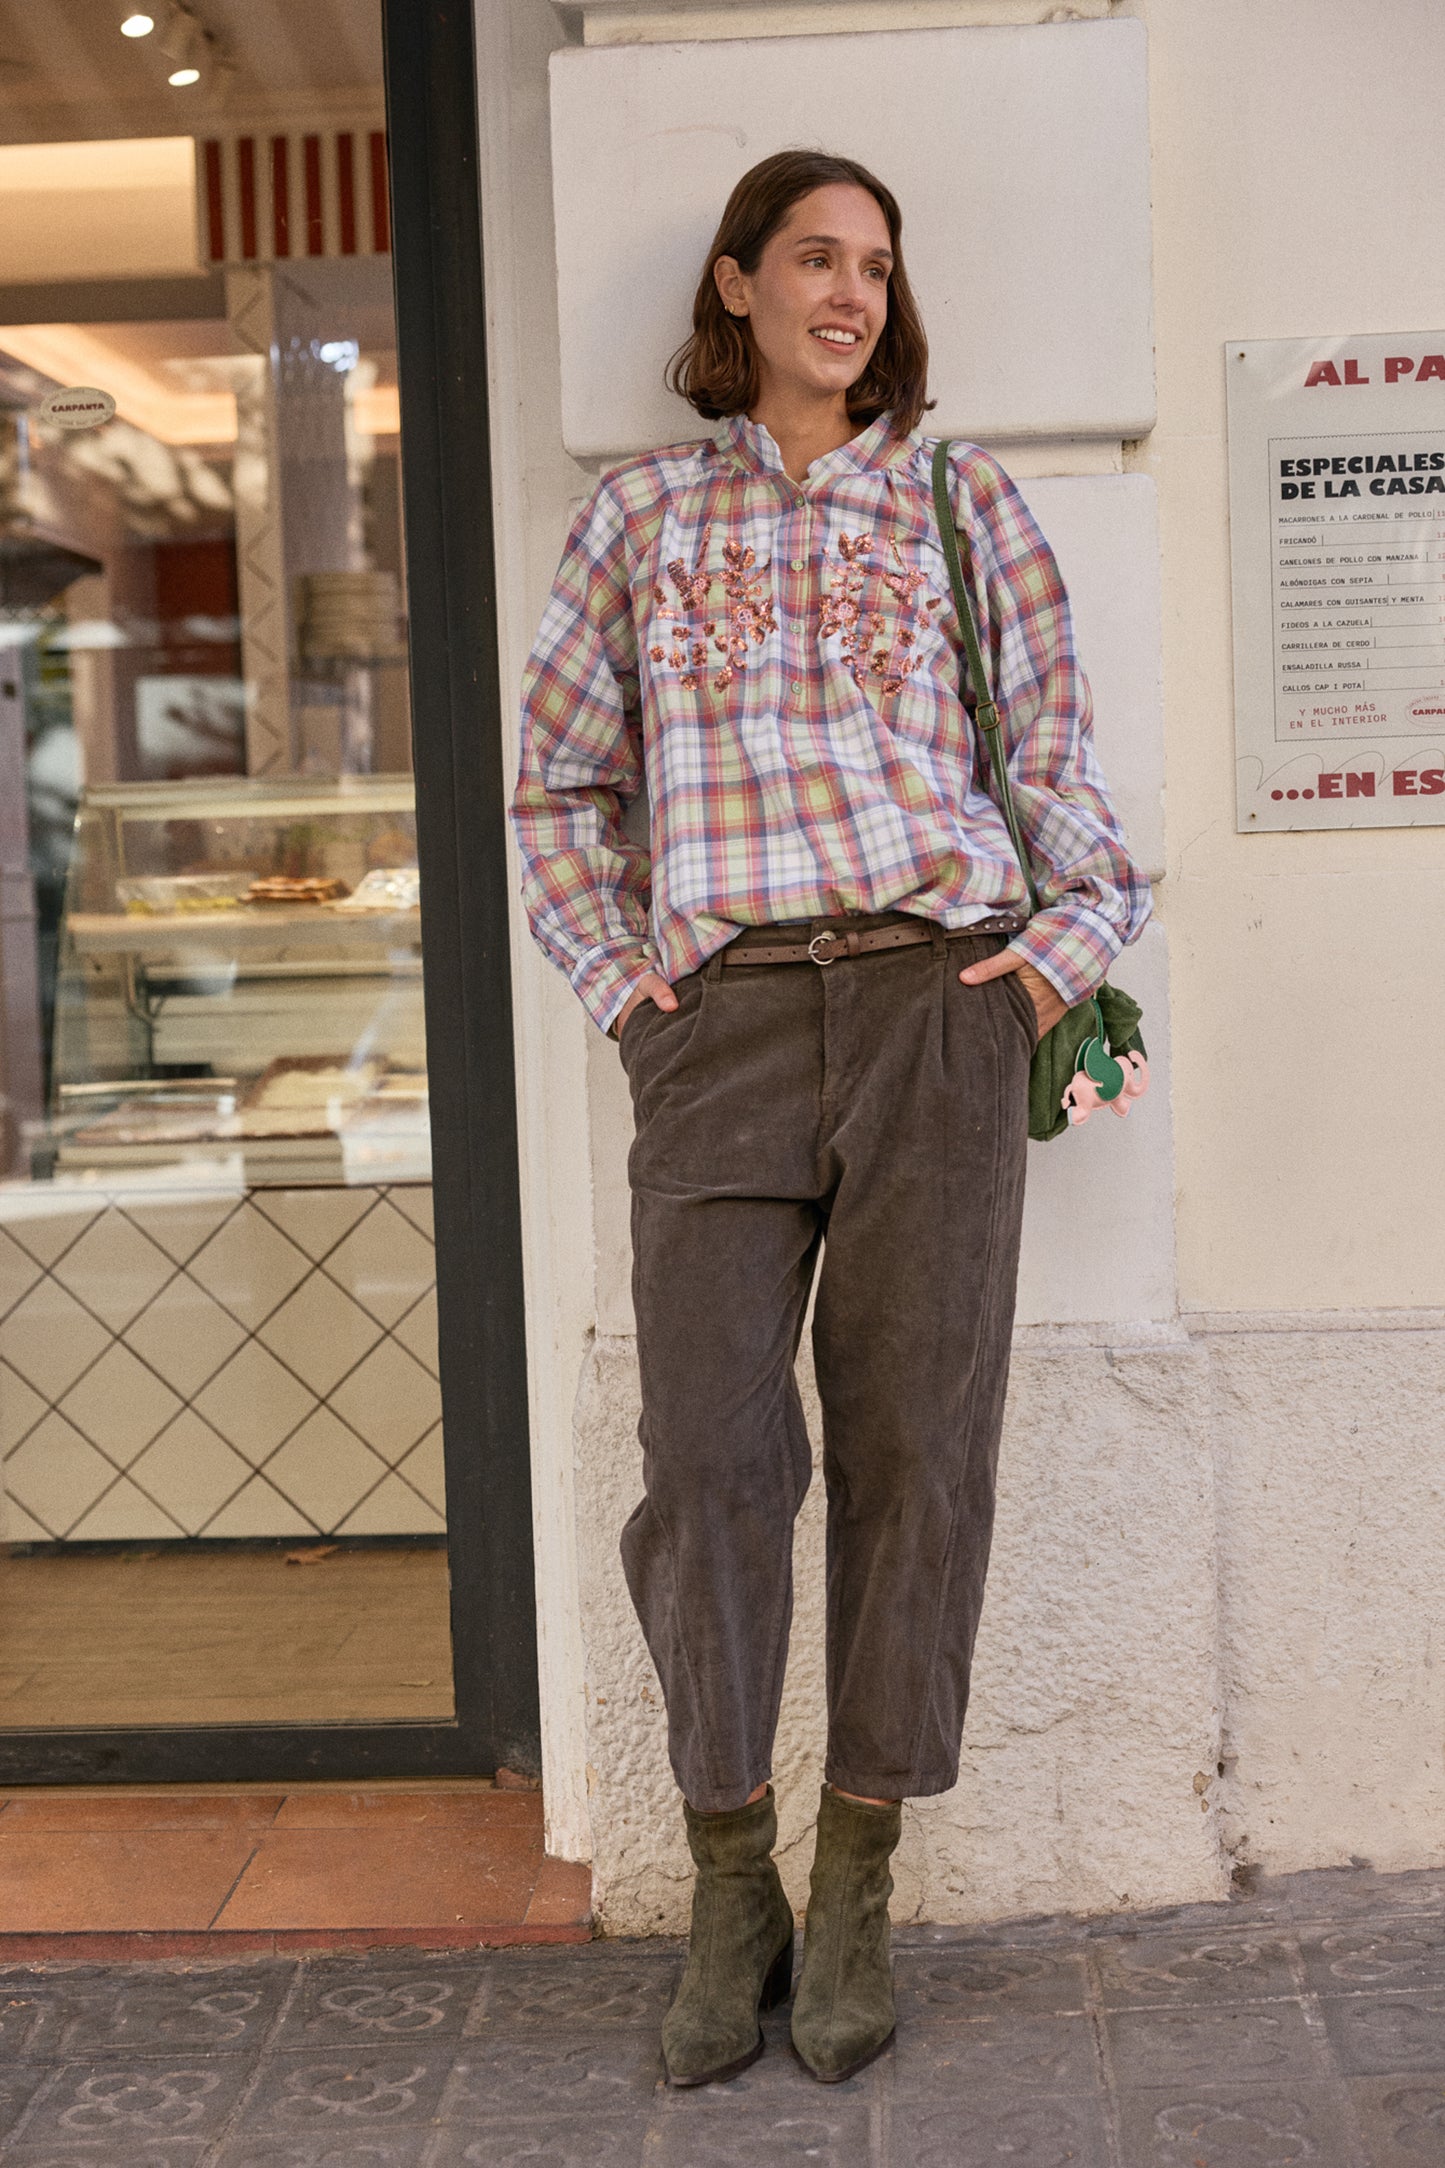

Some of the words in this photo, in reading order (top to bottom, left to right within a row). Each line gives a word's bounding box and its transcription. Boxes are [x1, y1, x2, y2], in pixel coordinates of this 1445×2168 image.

[1304, 359, 1370, 388] AL
[1384, 355, 1445, 383] PA
[51, 403, 105, 413] CARPANTA
[1280, 452, 1445, 477] ESPECIALES
[1281, 482, 1316, 500] DE
[1324, 480, 1361, 498] LA
[1369, 476, 1445, 496] CASA
[1278, 515, 1326, 524] MACARRONES
[1352, 513, 1389, 521] CARDENAL
[1279, 535, 1317, 545] FRICANDÓ
[1279, 558, 1322, 566] CANELONES
[1280, 578, 1327, 587] ALBÓNDIGAS
[1281, 600, 1323, 608] CALAMARES
[1345, 597, 1387, 605] GUISANTES
[1281, 621, 1309, 629] FIDEOS
[1281, 642, 1328, 650] CARRILLERA
[1346, 640, 1370, 648] CERDO
[1282, 662, 1334, 671] ENSALADILLA
[1337, 661, 1362, 669] RUSSA
[1315, 683, 1329, 691] CAP
[1342, 682, 1361, 690] POTA
[1299, 708, 1306, 716] Y
[1313, 705, 1348, 716] MUCHO
[1355, 701, 1376, 712] MÁS
[1412, 708, 1445, 716] CARPA
[1289, 720, 1303, 729] EN
[1311, 719, 1324, 728] EL
[1332, 714, 1387, 726] INTERIOR
[1393, 769, 1445, 796] ES
